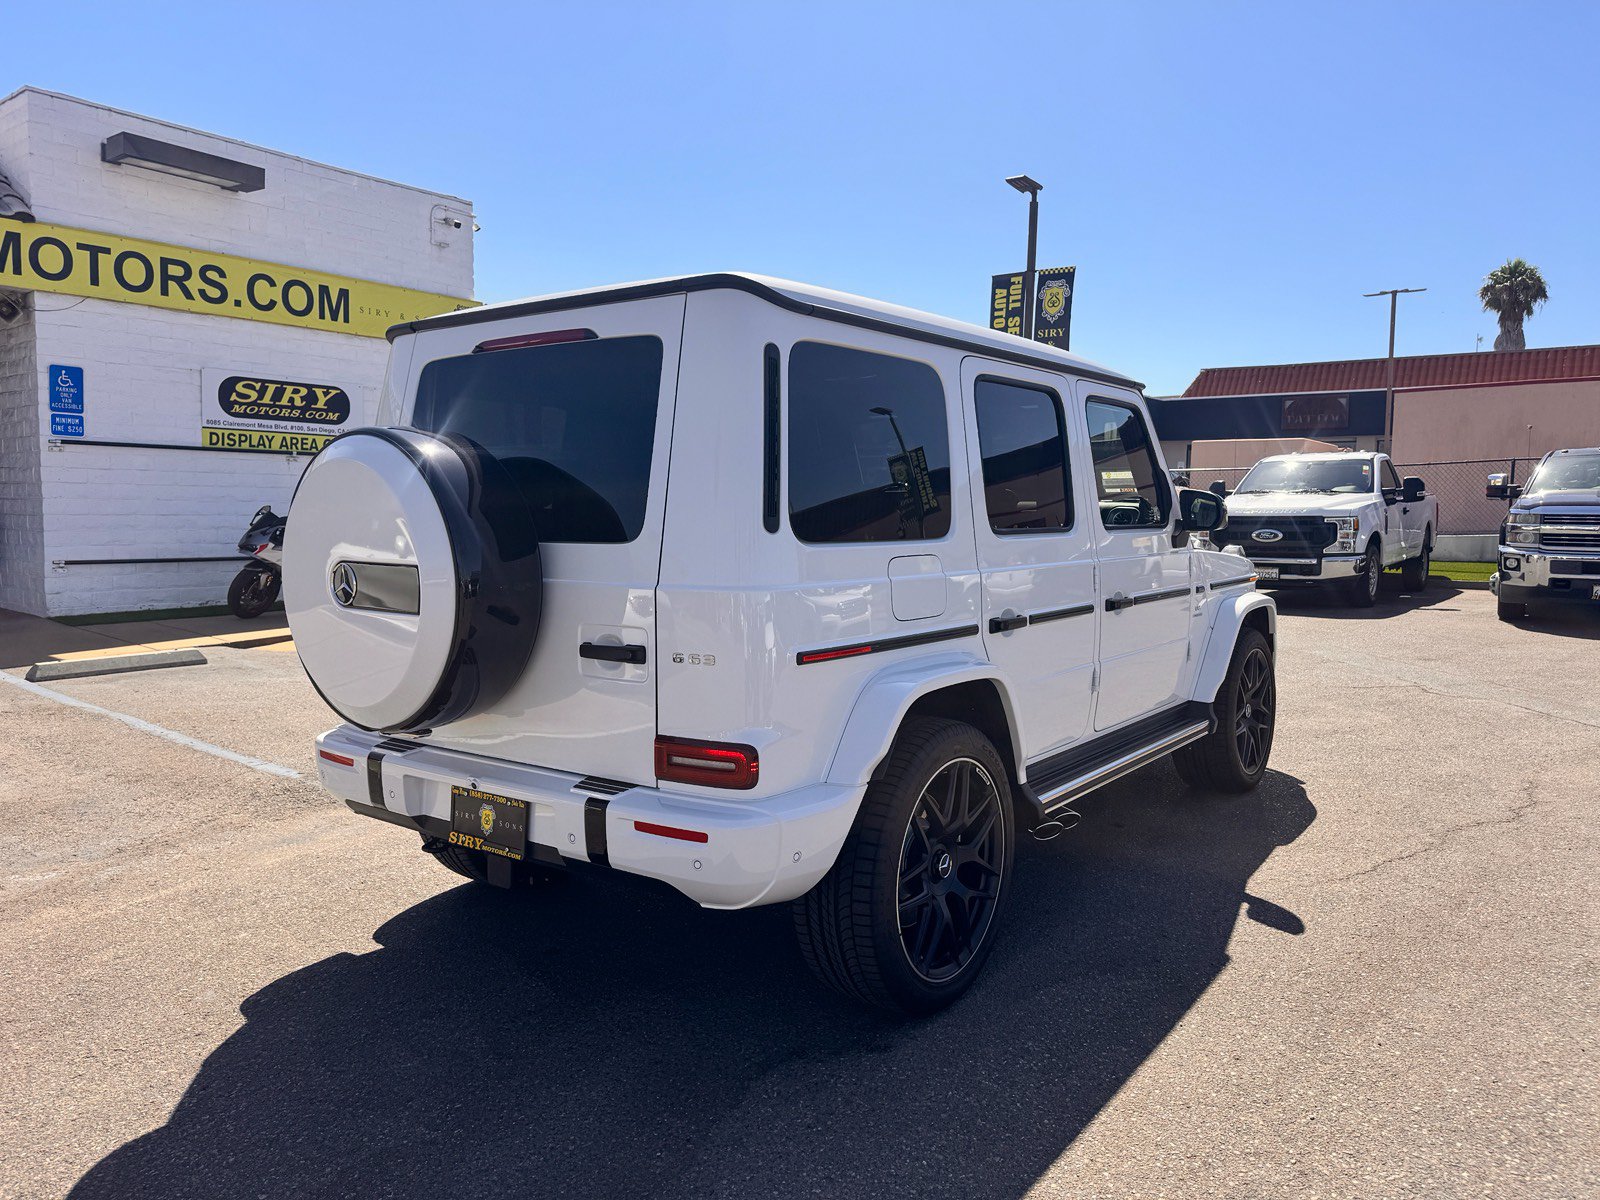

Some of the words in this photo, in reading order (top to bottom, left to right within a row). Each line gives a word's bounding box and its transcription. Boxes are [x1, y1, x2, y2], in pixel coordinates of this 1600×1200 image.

[1009, 276, 1023, 310] FULL
[359, 306, 390, 318] SIRY
[993, 289, 1007, 329] AUTO
[1037, 328, 1065, 338] SIRY
[230, 380, 340, 409] SIRY
[231, 404, 340, 421] MOTORS.COM
[222, 420, 256, 429] Clairemont
[209, 432, 276, 448] DISPLAY
[279, 437, 319, 451] AREA
[688, 653, 716, 666] 63
[455, 811, 475, 820] SIRY
[499, 820, 523, 832] SONS
[448, 831, 484, 850] SIRY
